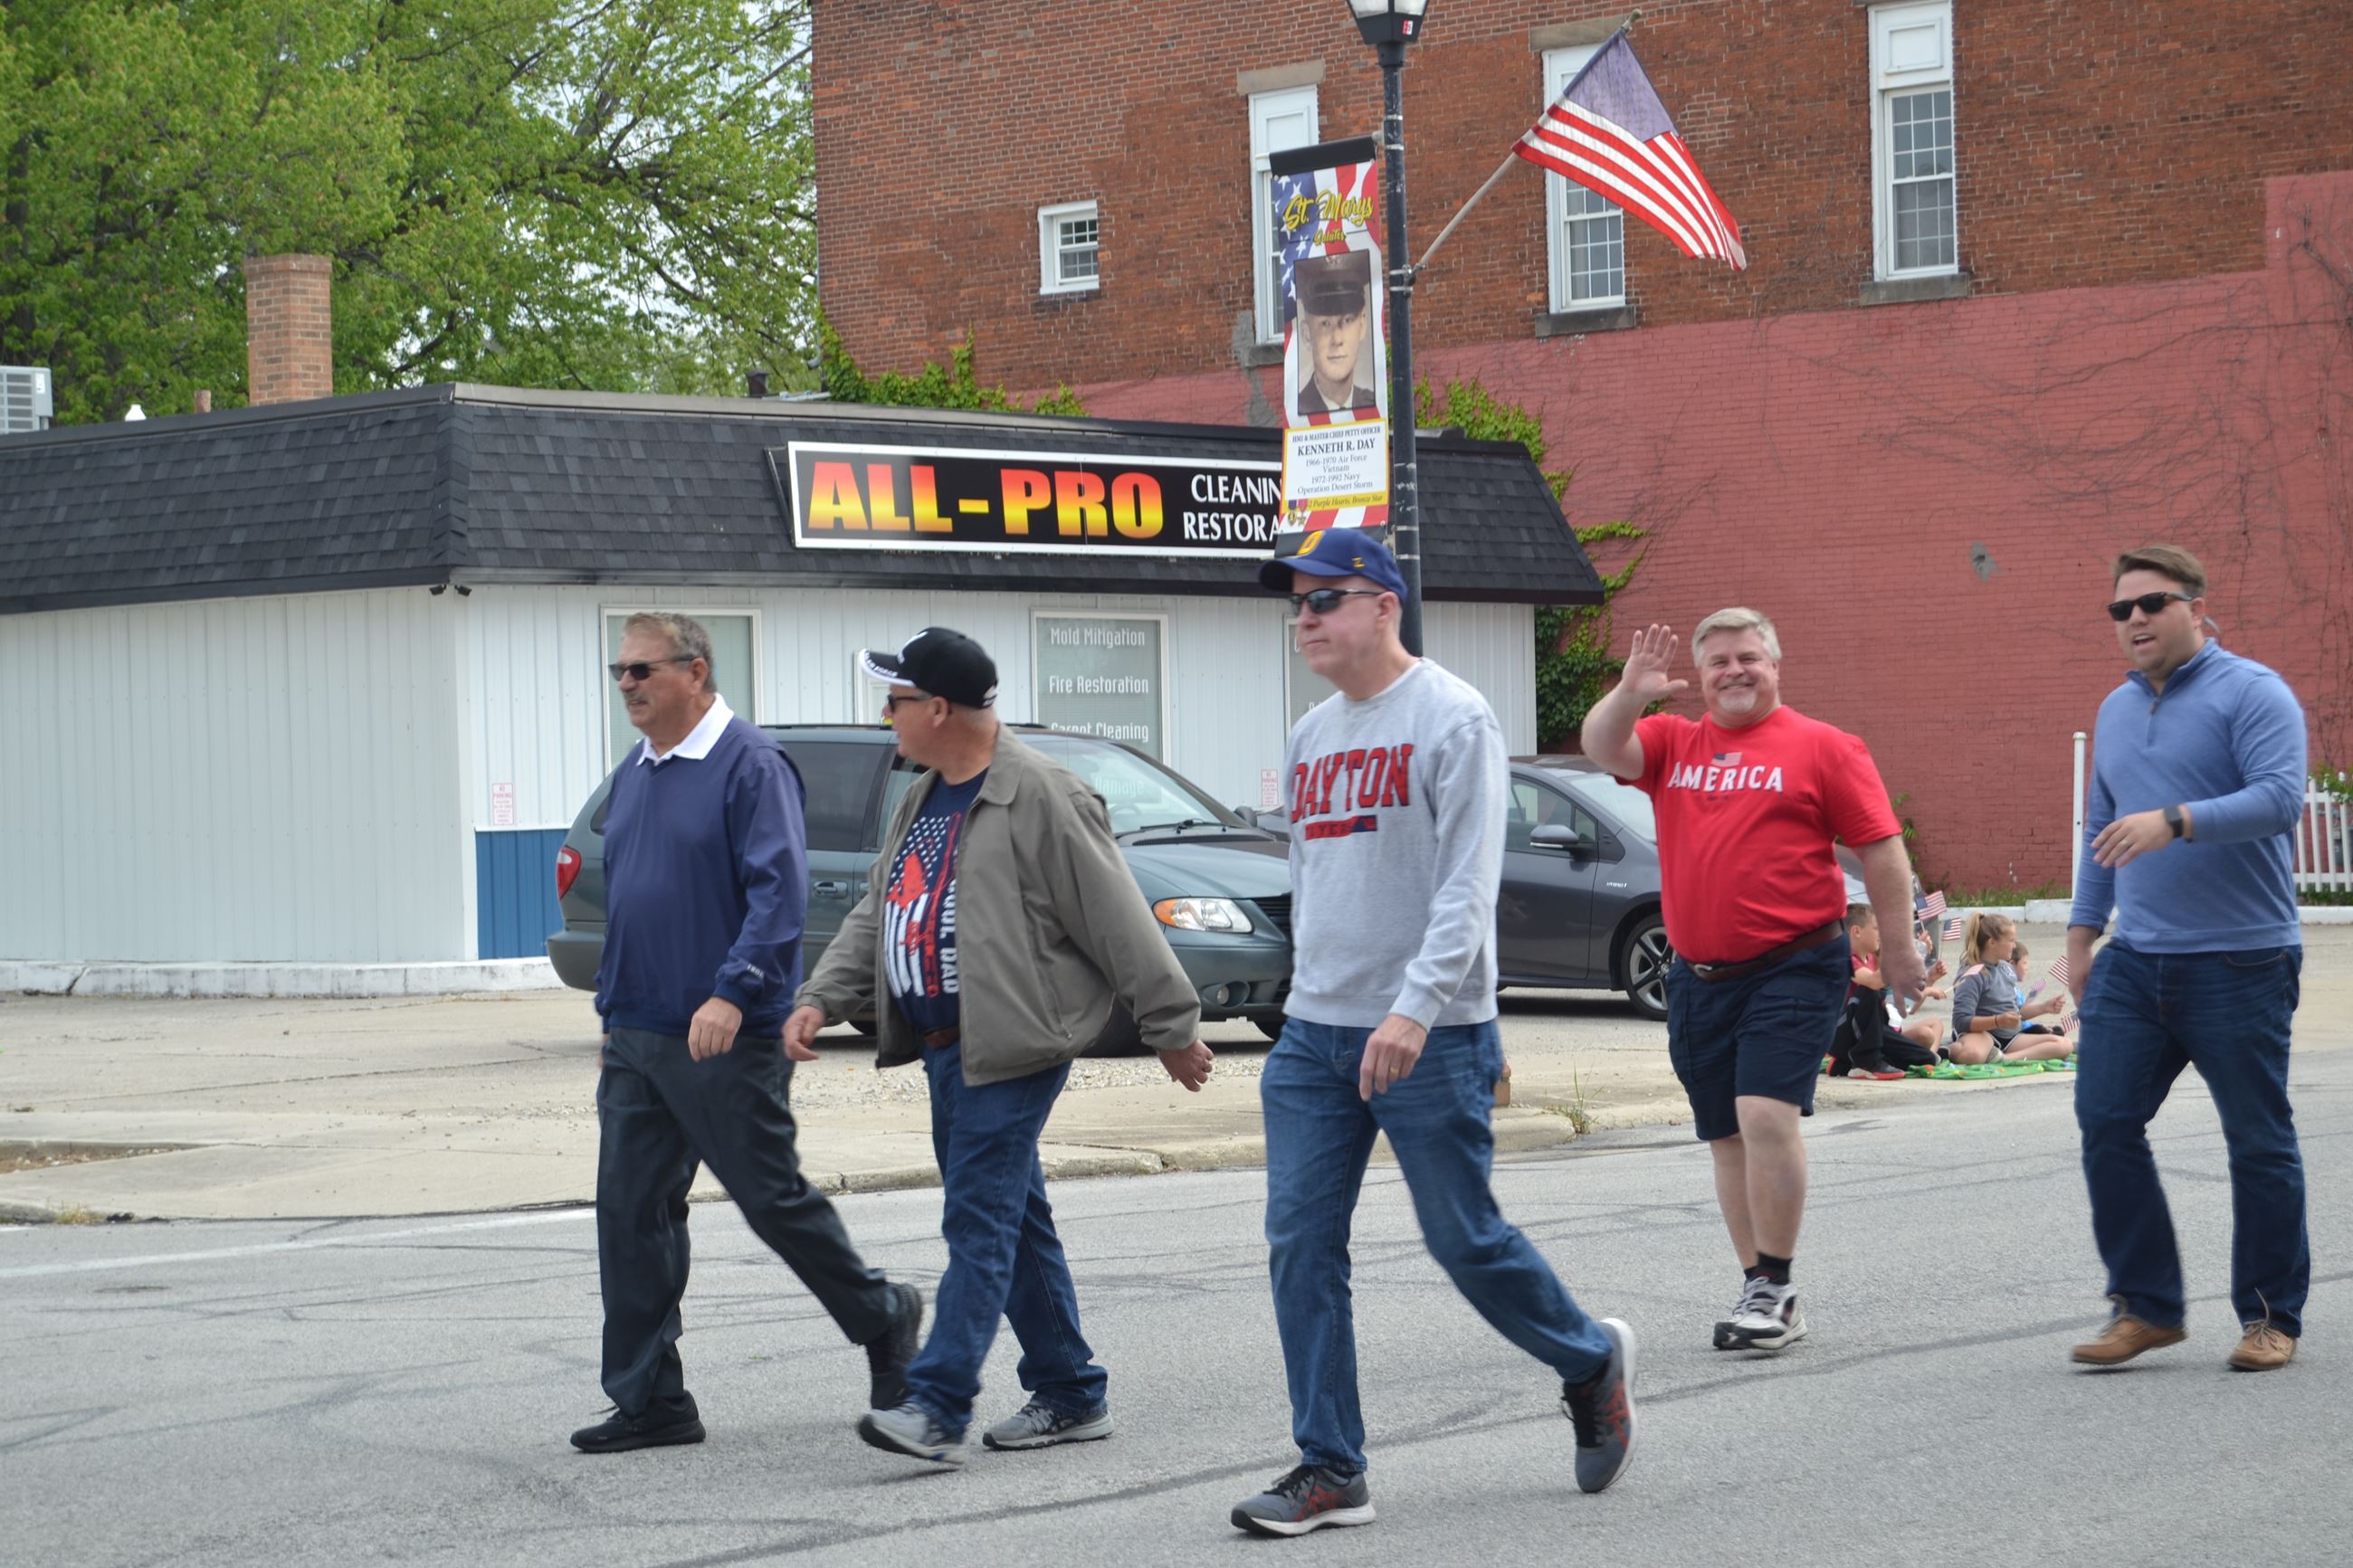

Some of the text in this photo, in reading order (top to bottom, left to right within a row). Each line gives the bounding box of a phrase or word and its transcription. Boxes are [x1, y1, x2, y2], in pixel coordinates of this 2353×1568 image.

[1285, 189, 1374, 230] St. Marys
[1313, 228, 1346, 246] Salutes
[1309, 432, 1329, 441] MASTER
[1329, 430, 1344, 439] CHIEF
[1345, 428, 1360, 437] PETTY
[1361, 426, 1381, 435] OFFICER
[1297, 438, 1376, 456] KENNETH R. DAY
[1338, 455, 1348, 463] Air
[1350, 453, 1367, 462] Force
[1323, 464, 1349, 473] Vietnam
[1344, 472, 1360, 481] Navy
[1298, 480, 1373, 495] Operation Desert Storm
[807, 461, 1164, 540] ALL-PRO
[1313, 499, 1330, 508] Purple
[1051, 627, 1145, 649] Mold Mitigation
[1049, 675, 1149, 694] Fire Restoration
[1096, 722, 1149, 743] Cleaning
[1291, 743, 1415, 824] DAYTON
[1667, 761, 1784, 793] AMERICA
[940, 947, 959, 993] DAD
